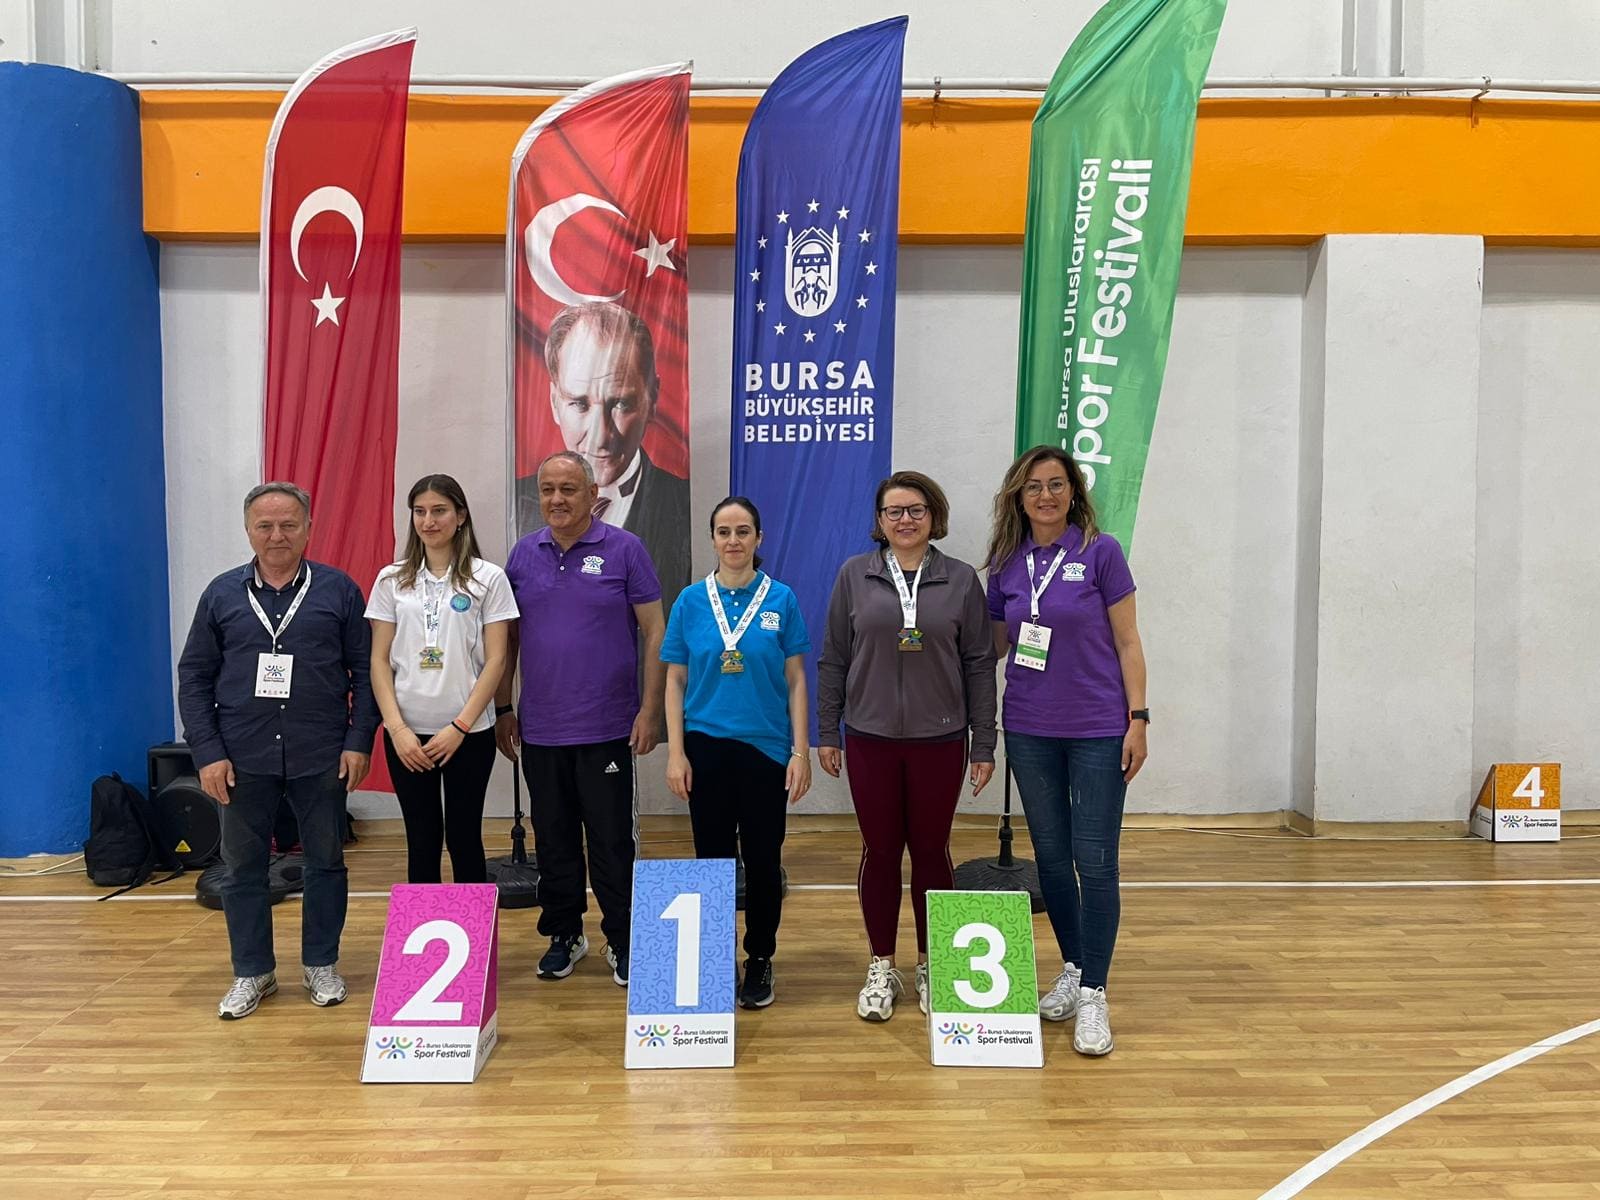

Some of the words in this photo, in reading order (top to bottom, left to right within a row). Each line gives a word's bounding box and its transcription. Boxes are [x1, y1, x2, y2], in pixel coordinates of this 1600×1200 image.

[1062, 158, 1102, 337] Uluslararası
[1076, 159, 1154, 367] Festivali
[745, 360, 875, 392] BURSA
[1057, 347, 1073, 430] Bursa
[744, 391, 874, 420] BÜYÜKŞEHİR
[744, 418, 875, 442] BELEDİYESİ
[1512, 766, 1545, 808] 4
[659, 893, 701, 1007] 1
[392, 919, 470, 1022] 2
[952, 922, 1010, 1009] 3
[415, 1036, 426, 1048] 2.
[672, 1024, 684, 1036] 2.
[672, 1036, 693, 1047] Spor
[694, 1036, 728, 1045] Festivali
[976, 1023, 987, 1035] 2.
[977, 1035, 997, 1045] Spor
[998, 1035, 1033, 1045] Festivali
[413, 1049, 435, 1060] Spor
[435, 1049, 471, 1058] Festivali
